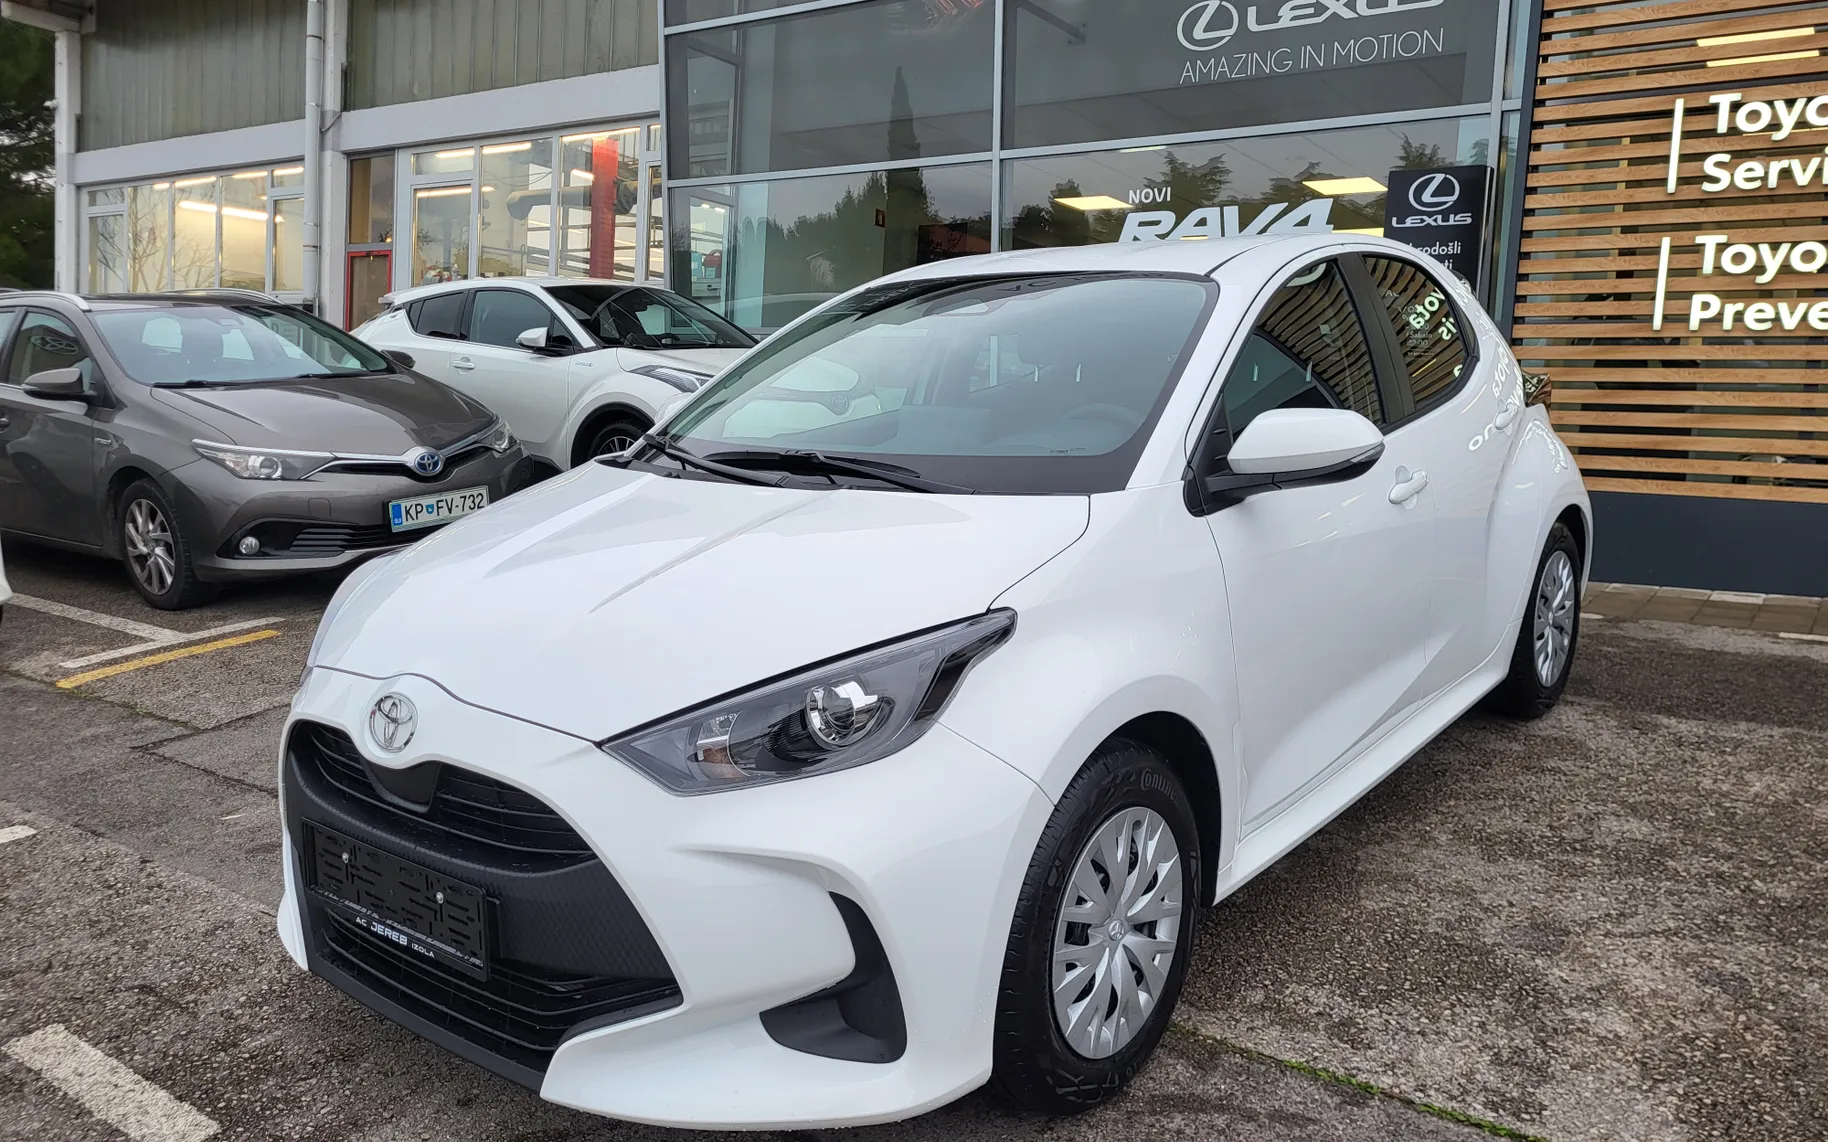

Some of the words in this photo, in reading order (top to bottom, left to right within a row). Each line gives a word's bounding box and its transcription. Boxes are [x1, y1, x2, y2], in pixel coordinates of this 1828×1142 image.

[1179, 48, 1293, 84] AMAZING
[1300, 42, 1325, 70] IN
[1333, 27, 1444, 66] MOTION
[1128, 187, 1172, 204] NOVI
[1118, 198, 1334, 243] RAV4
[1391, 212, 1472, 228] LEXUS
[1695, 234, 1827, 284] Toyo
[404, 503, 424, 522] KP
[437, 493, 485, 516] FV-732
[355, 916, 368, 928] AC
[370, 922, 408, 946] JEREB
[411, 941, 435, 959] IZOLA
